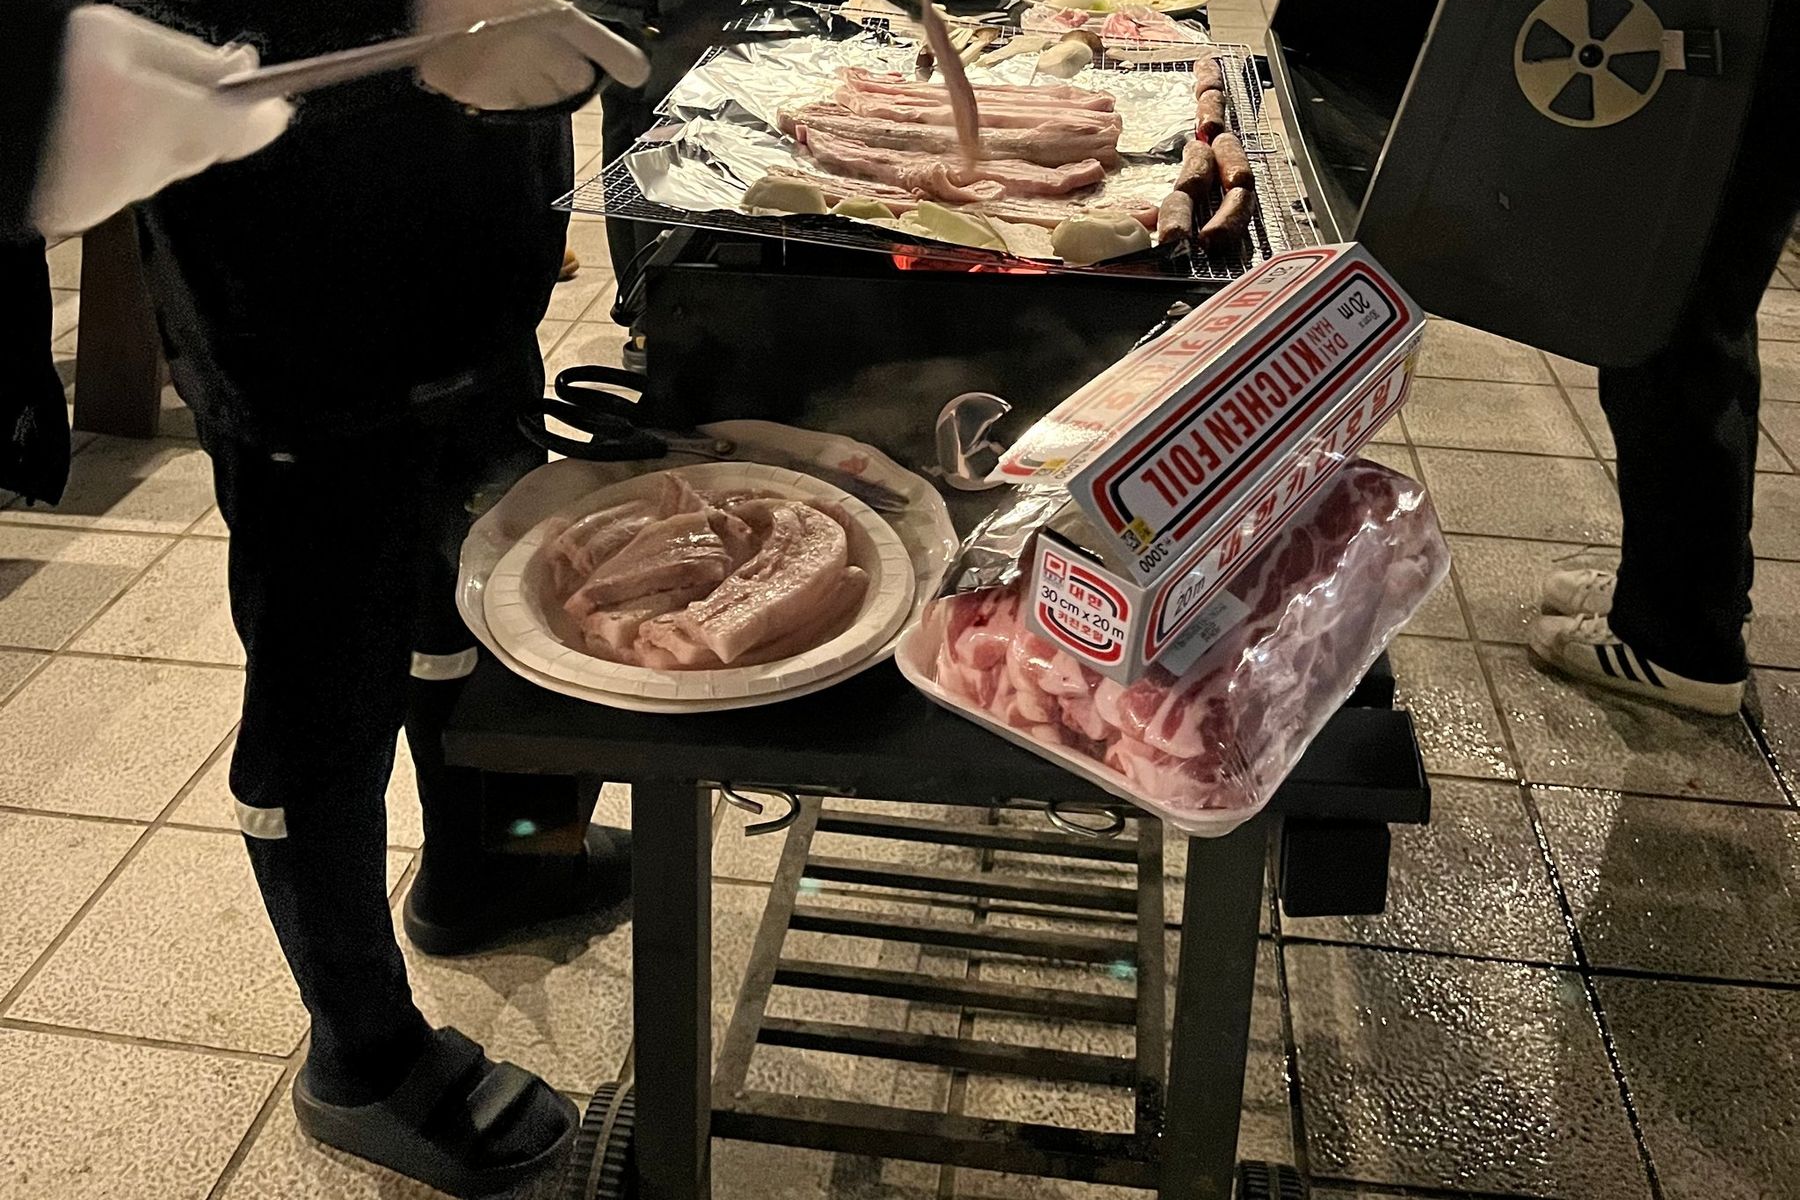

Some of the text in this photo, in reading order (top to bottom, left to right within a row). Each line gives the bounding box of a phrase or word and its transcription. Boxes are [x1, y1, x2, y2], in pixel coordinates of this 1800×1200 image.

[1304, 316, 1336, 346] HAN
[1318, 332, 1349, 362] DAI
[1141, 337, 1328, 509] KITCHEN FOIL
[1041, 585, 1058, 603] 30
[1092, 614, 1110, 632] 20
[1068, 583, 1103, 611] 대한
